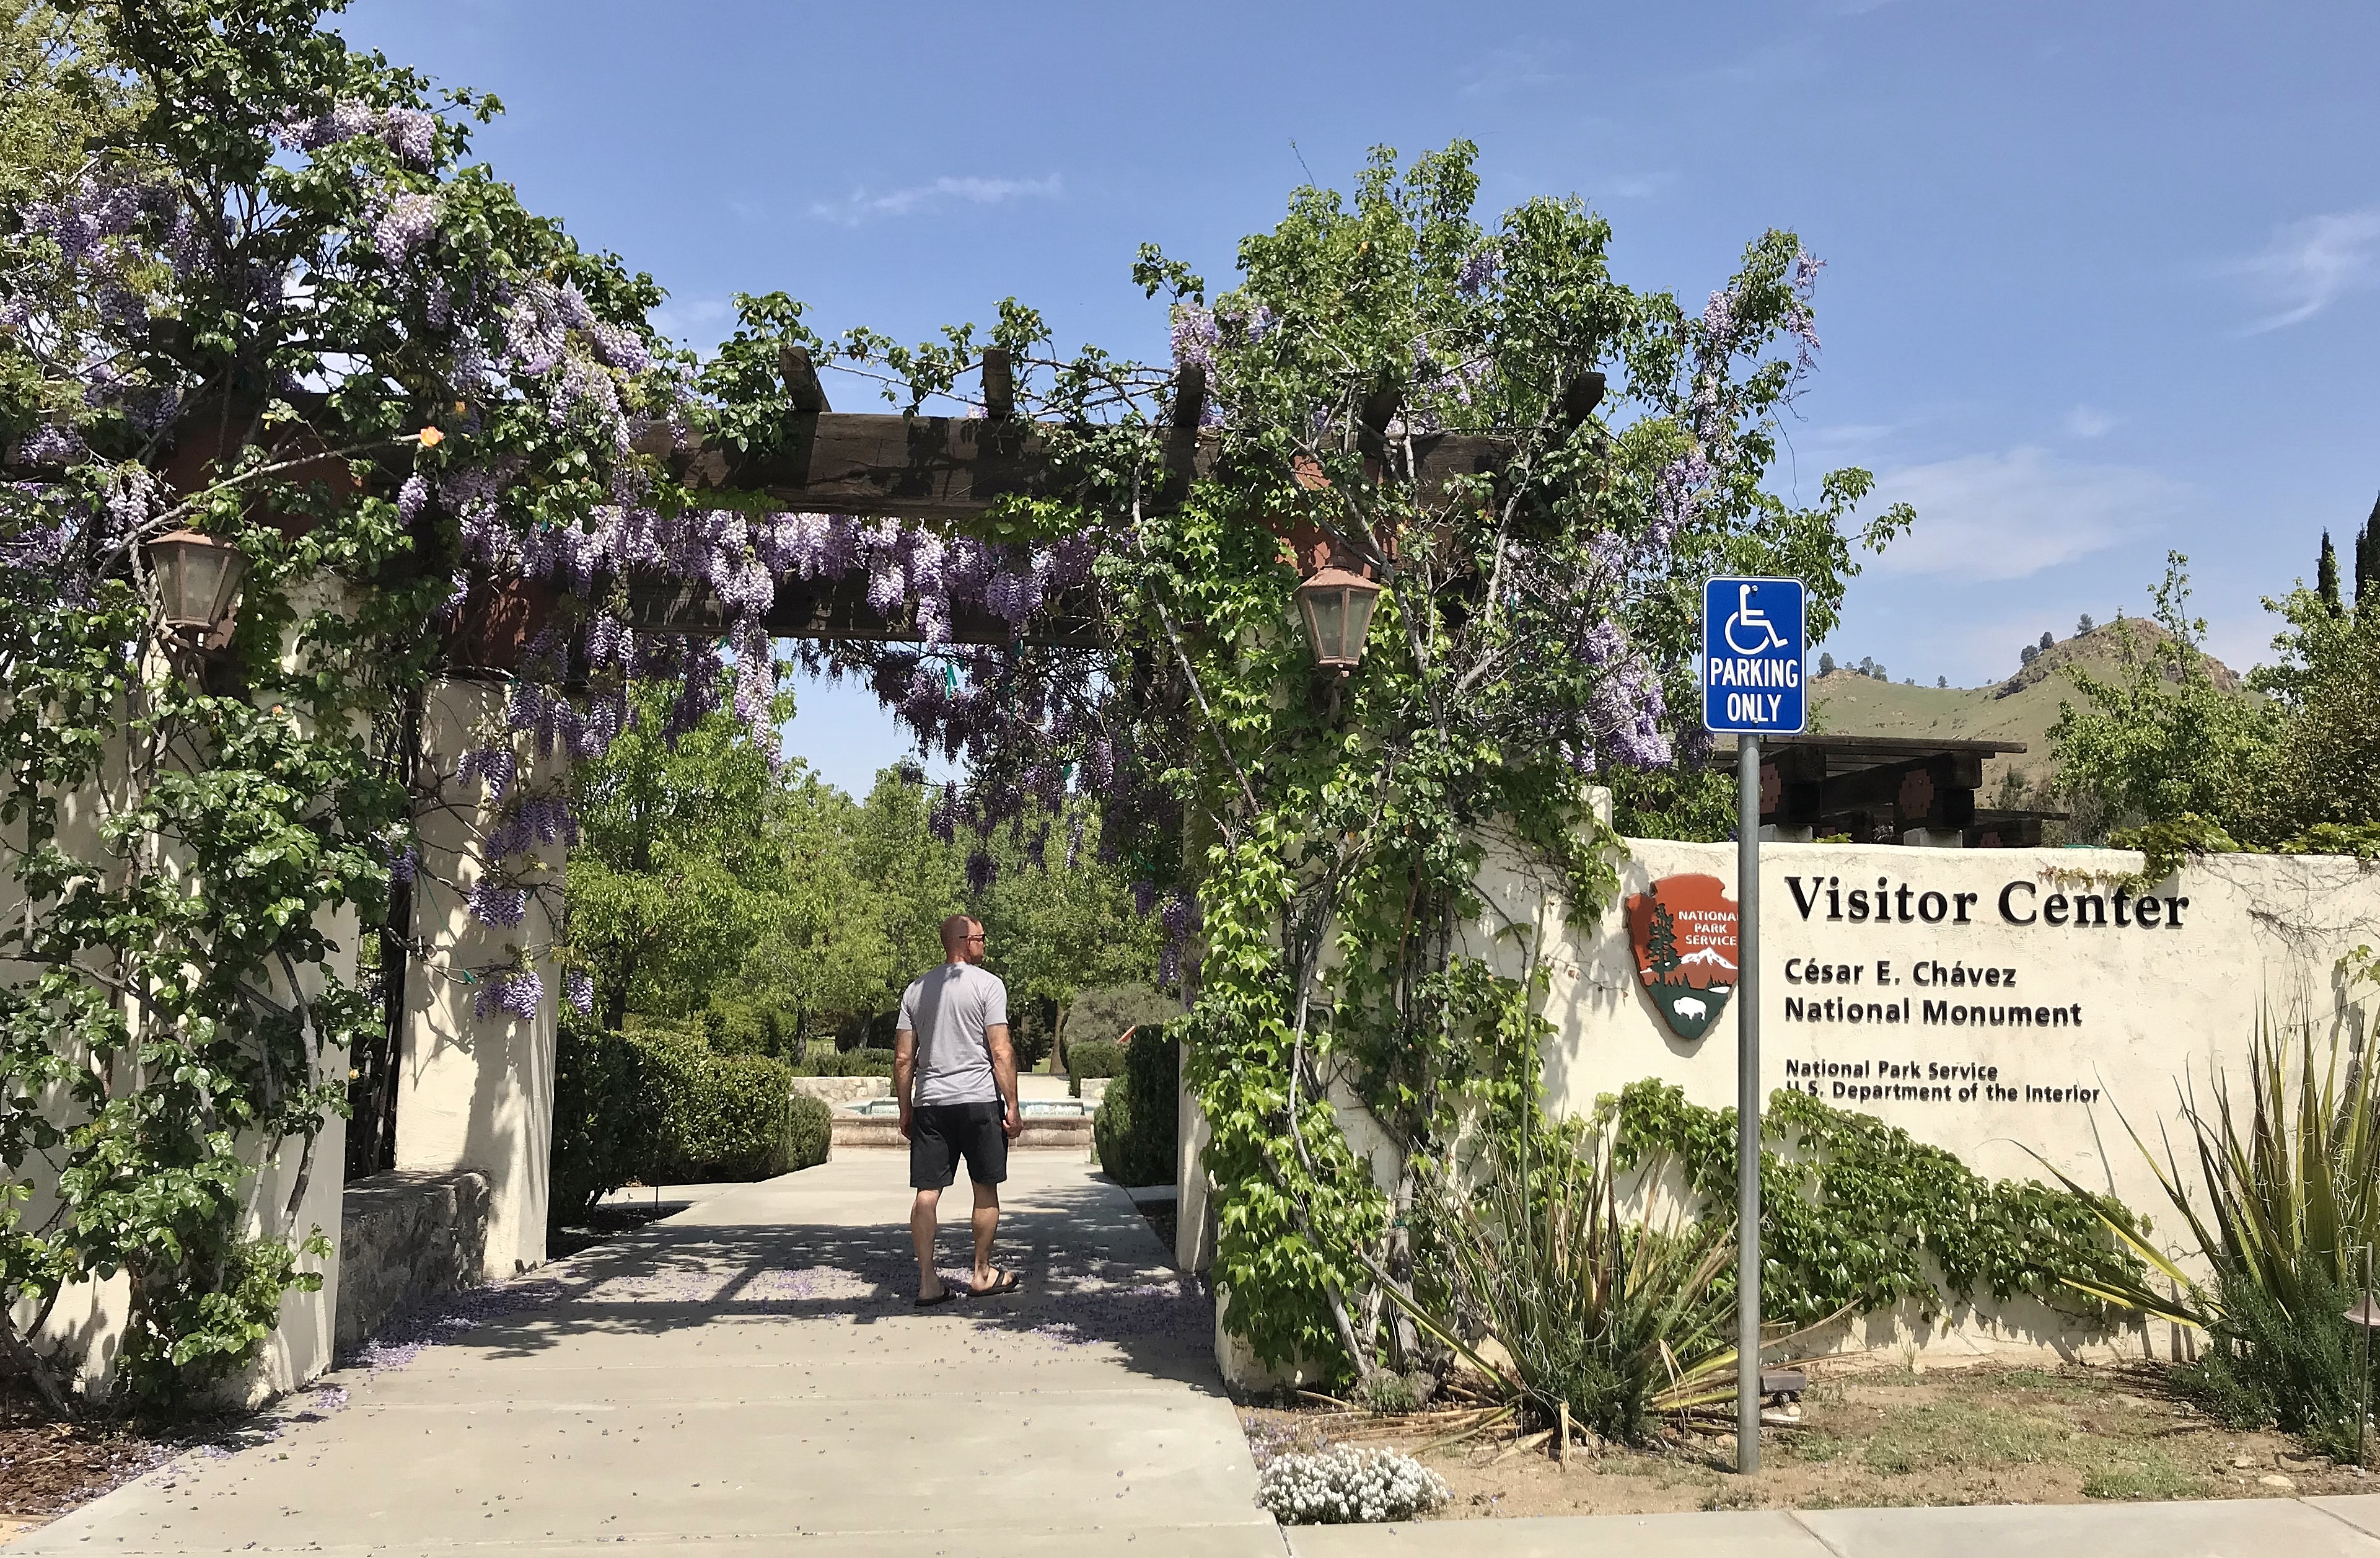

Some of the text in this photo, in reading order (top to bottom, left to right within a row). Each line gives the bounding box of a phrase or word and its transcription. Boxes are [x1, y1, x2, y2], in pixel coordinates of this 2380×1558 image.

[1710, 658, 1798, 688] PARKING
[1727, 693, 1782, 722] ONLY
[1785, 876, 2190, 928] Visitor Center
[1685, 935, 1737, 946] SERVICE
[1694, 923, 1728, 933] PARK
[1785, 958, 2016, 987] César E. Chávez
[1785, 997, 2083, 1028] National Monument
[1786, 1058, 1998, 1081] National Park Service
[1833, 1081, 1952, 1103] Department
[1959, 1083, 1978, 1102] of
[1986, 1083, 2018, 1102] the
[2026, 1085, 2100, 1103] Interior
